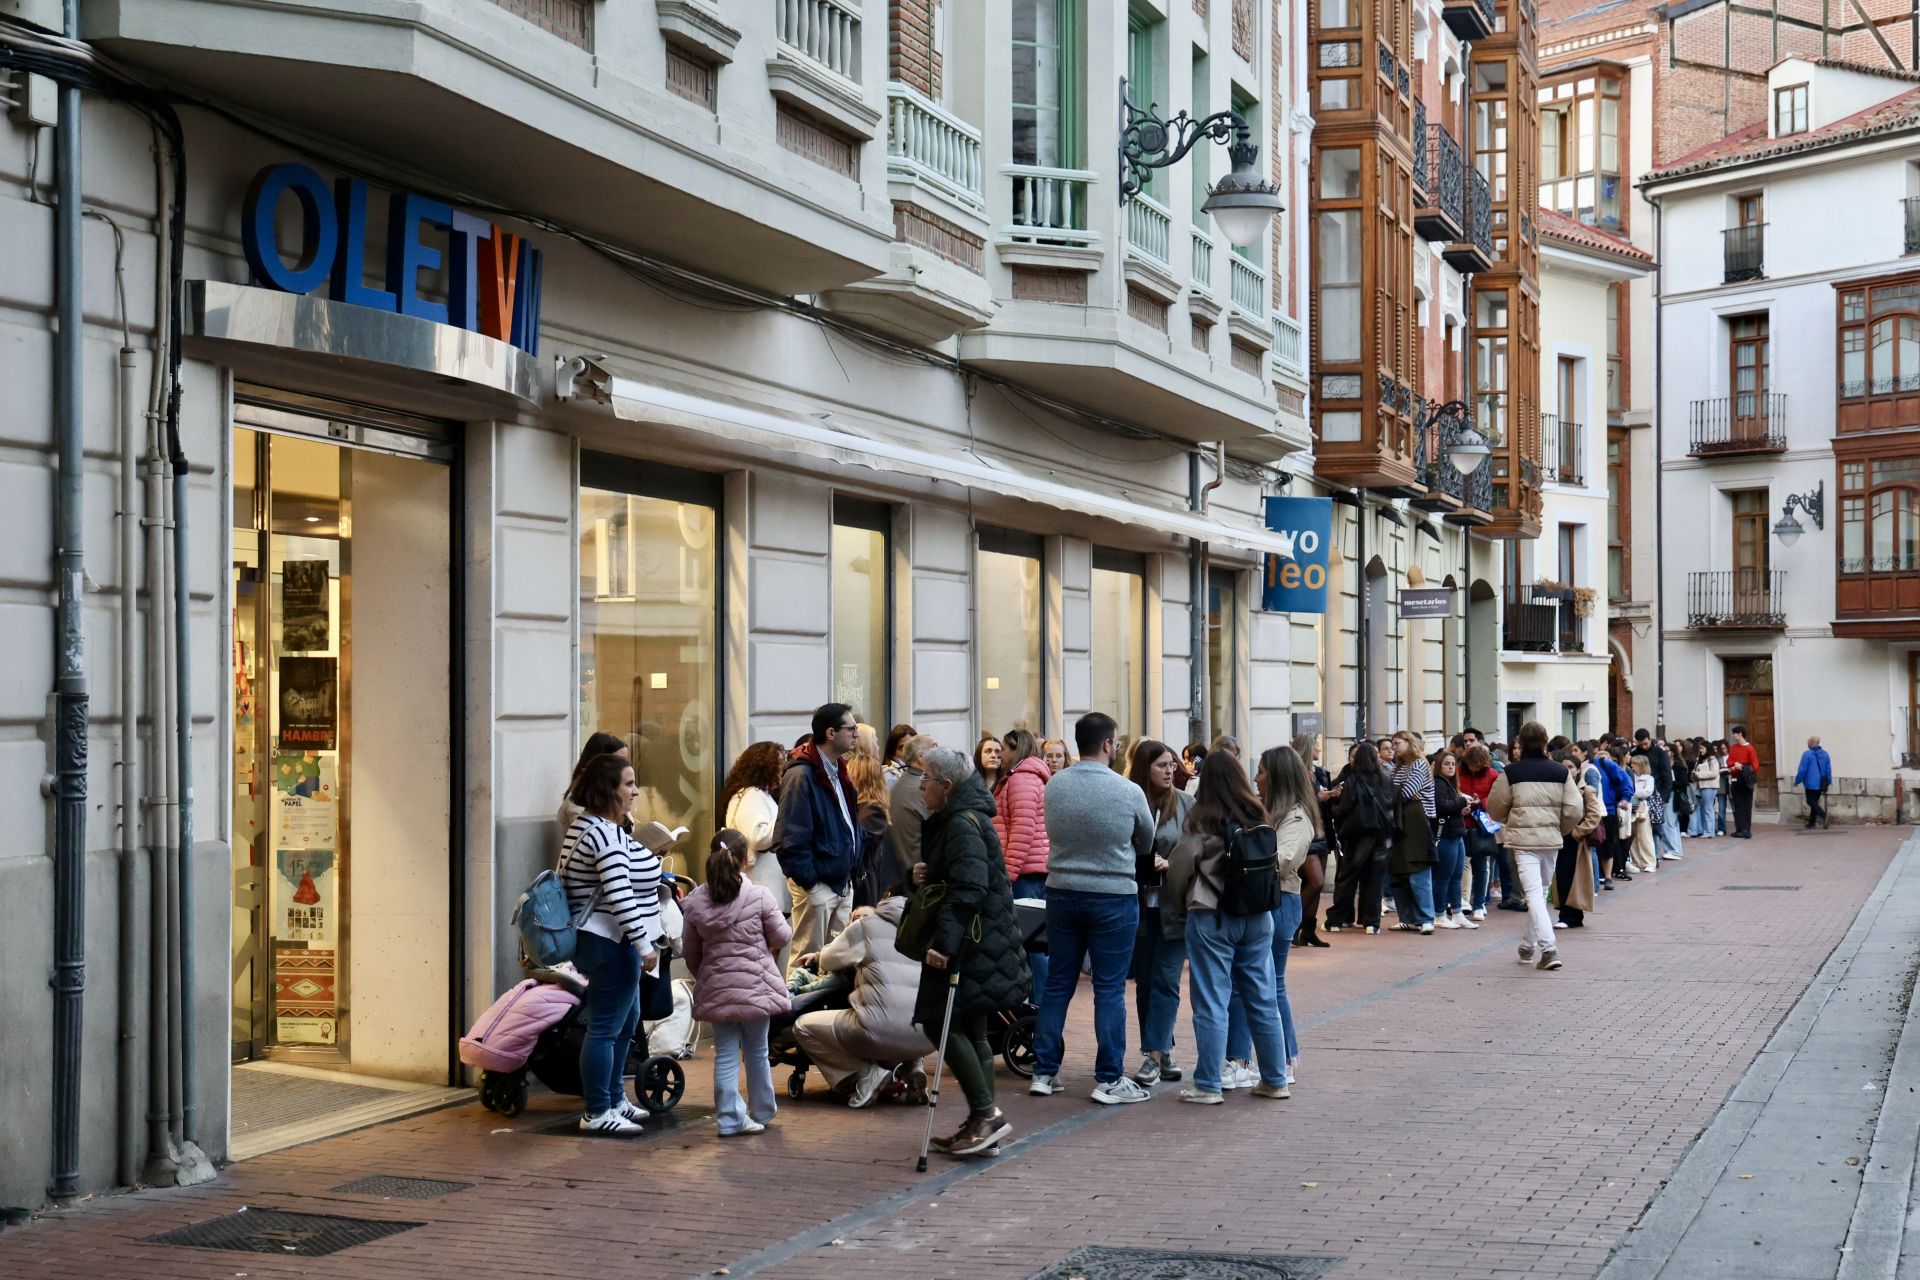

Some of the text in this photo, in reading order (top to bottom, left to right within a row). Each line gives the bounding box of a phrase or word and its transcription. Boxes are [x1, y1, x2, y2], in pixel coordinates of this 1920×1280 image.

[241, 162, 544, 359] OLETVM
[1268, 552, 1326, 590] leo
[282, 730, 335, 741] HAMBRE
